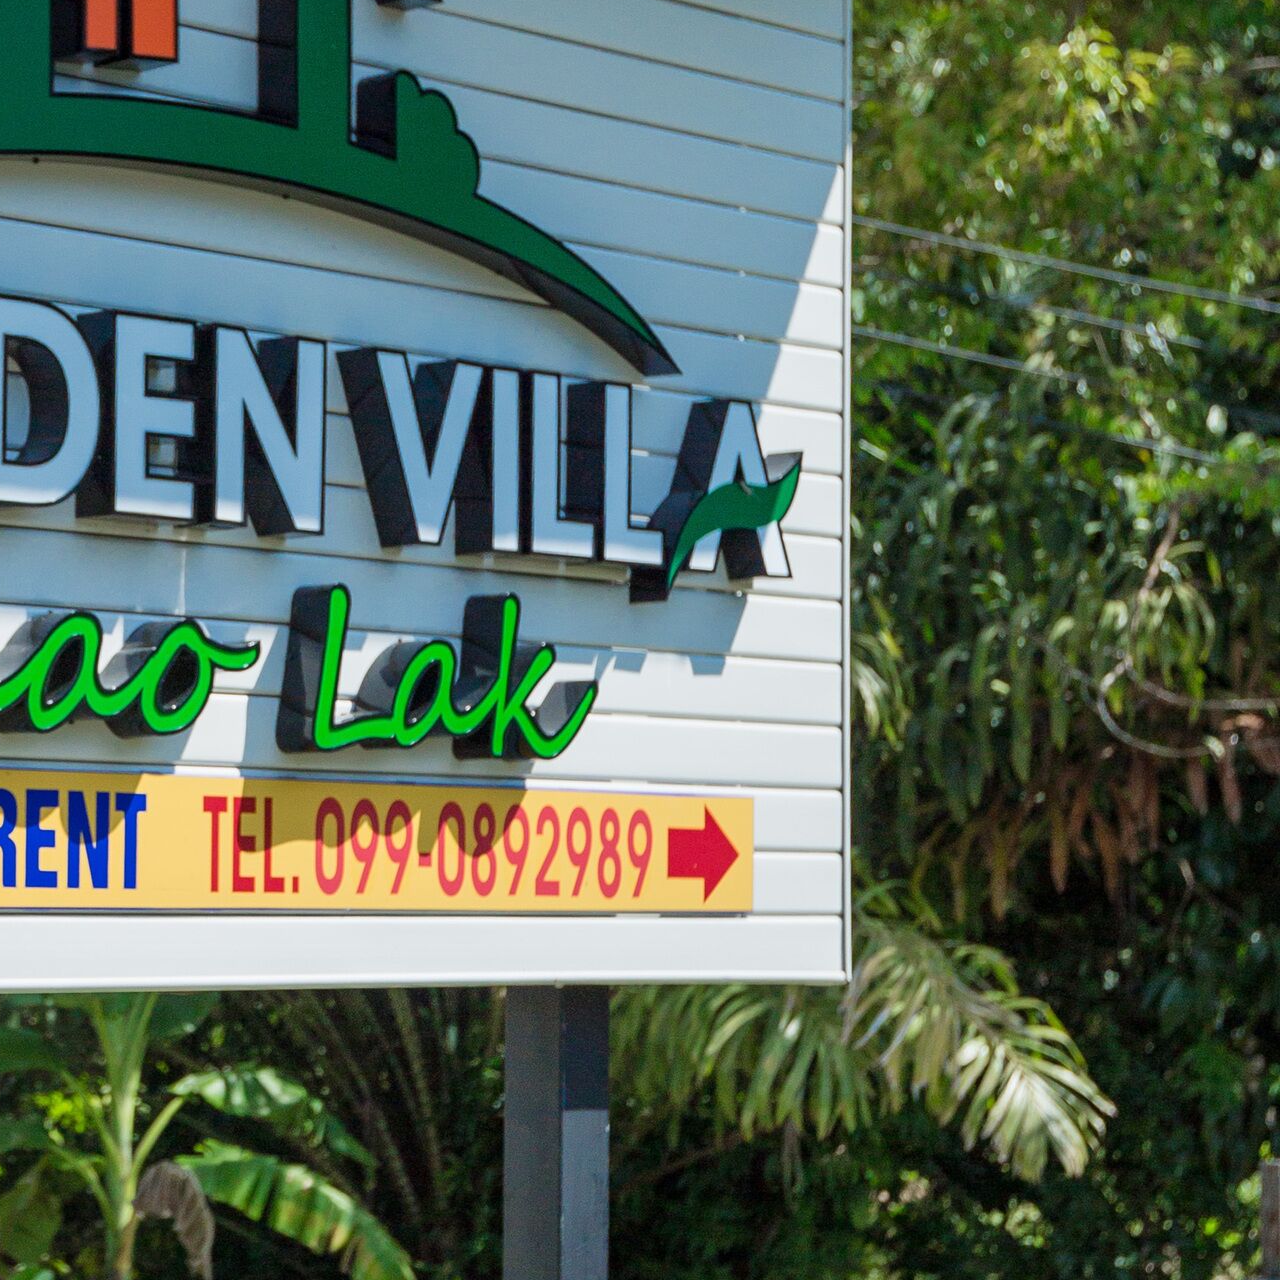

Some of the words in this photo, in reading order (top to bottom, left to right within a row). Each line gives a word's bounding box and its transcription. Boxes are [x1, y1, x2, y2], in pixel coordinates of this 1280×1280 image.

[374, 349, 802, 588] VILLA
[313, 582, 599, 760] Lak
[202, 795, 300, 895] TEL.
[313, 796, 655, 901] 099-0892989
